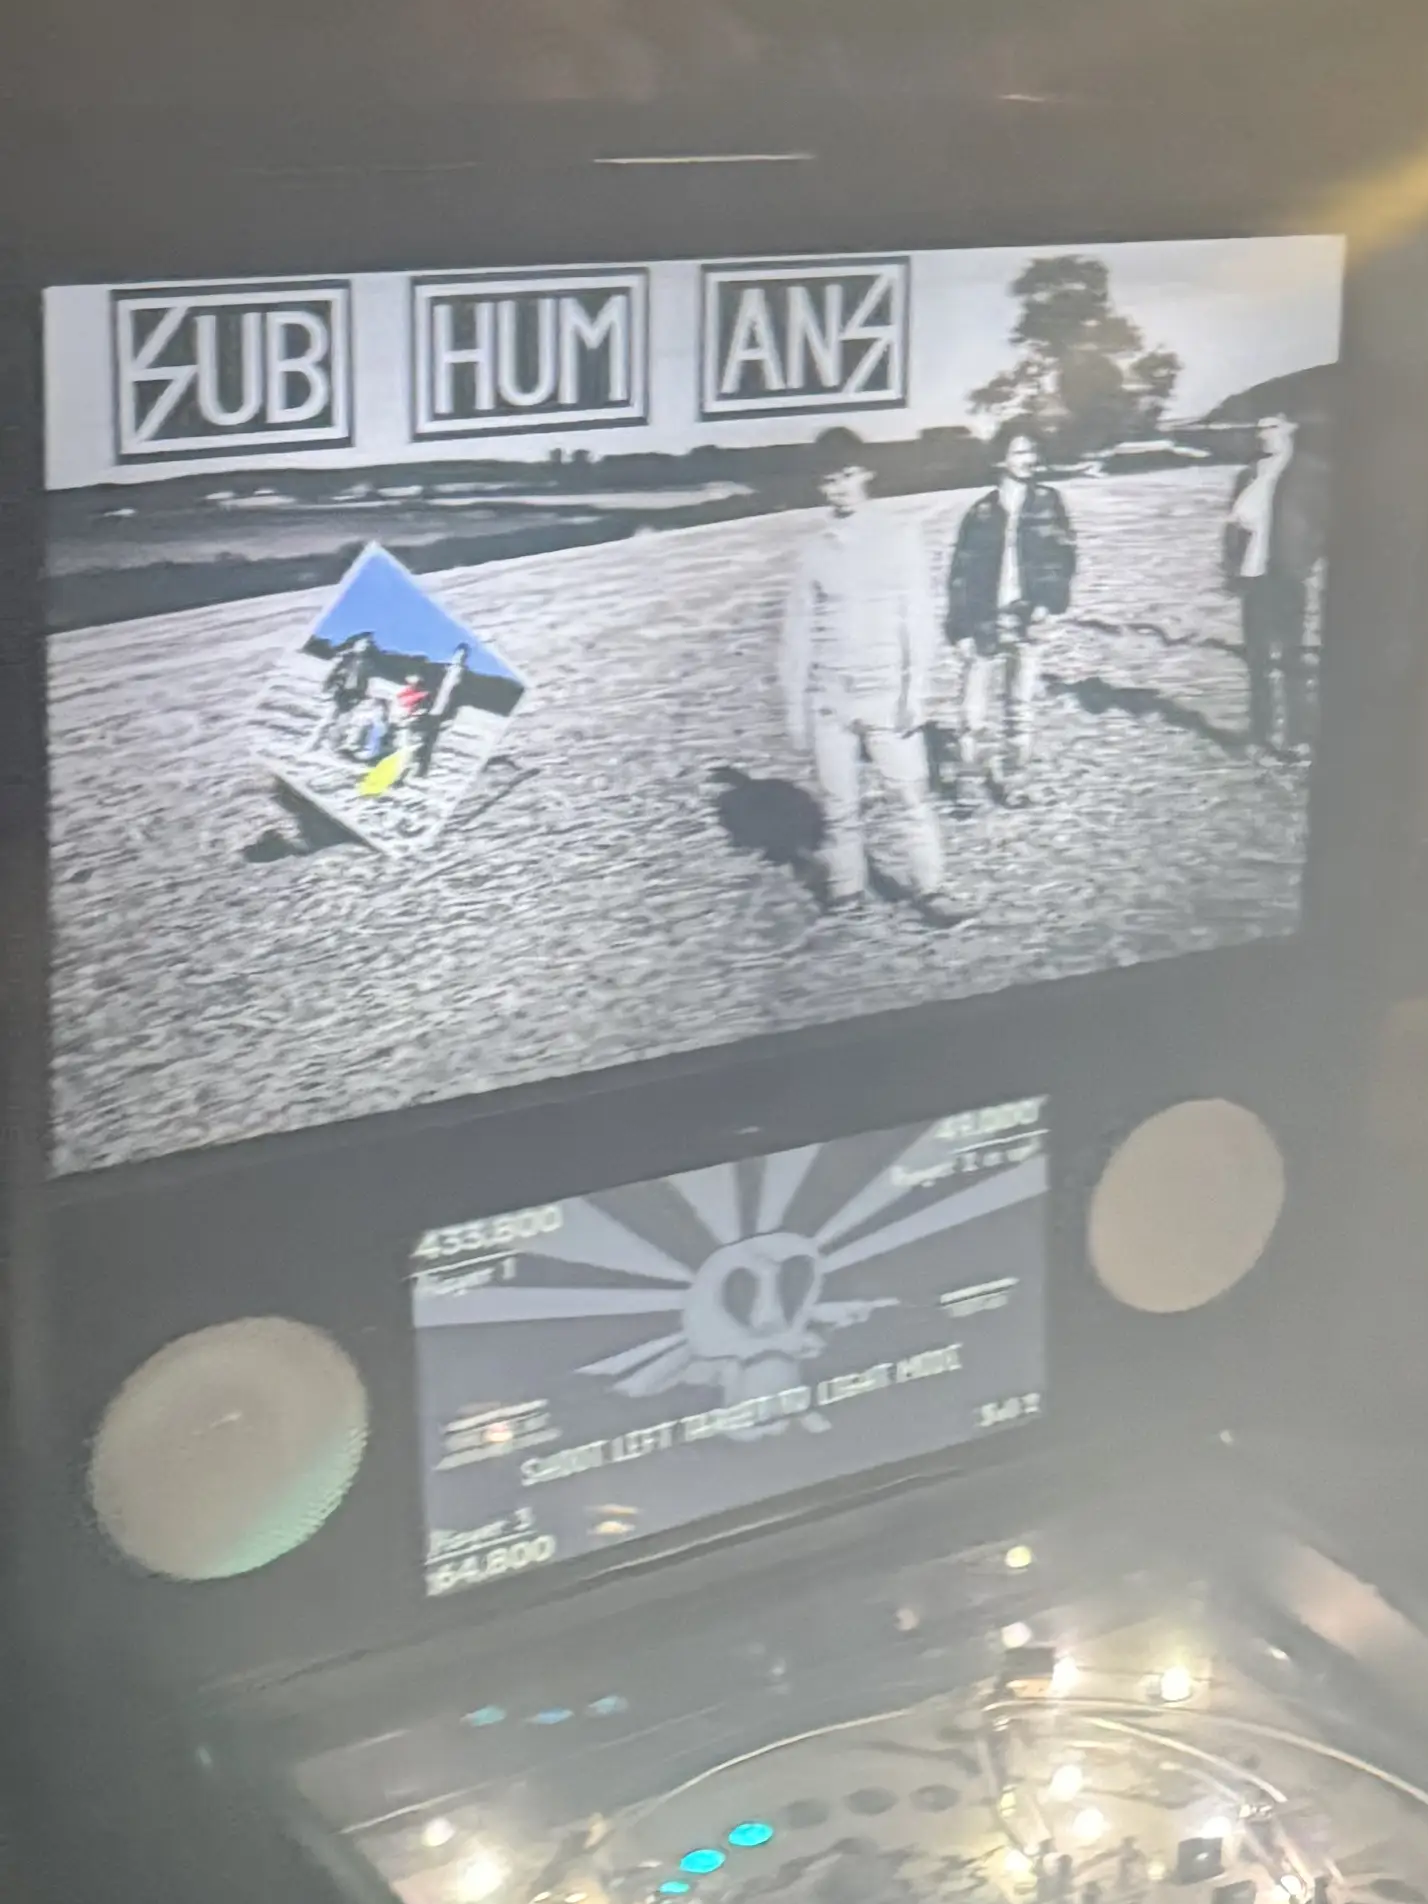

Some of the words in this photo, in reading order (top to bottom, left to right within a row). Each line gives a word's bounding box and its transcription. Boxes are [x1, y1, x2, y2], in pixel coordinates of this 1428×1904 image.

[132, 301, 331, 442] SUB
[434, 293, 628, 414] HUM
[722, 273, 898, 396] ANS
